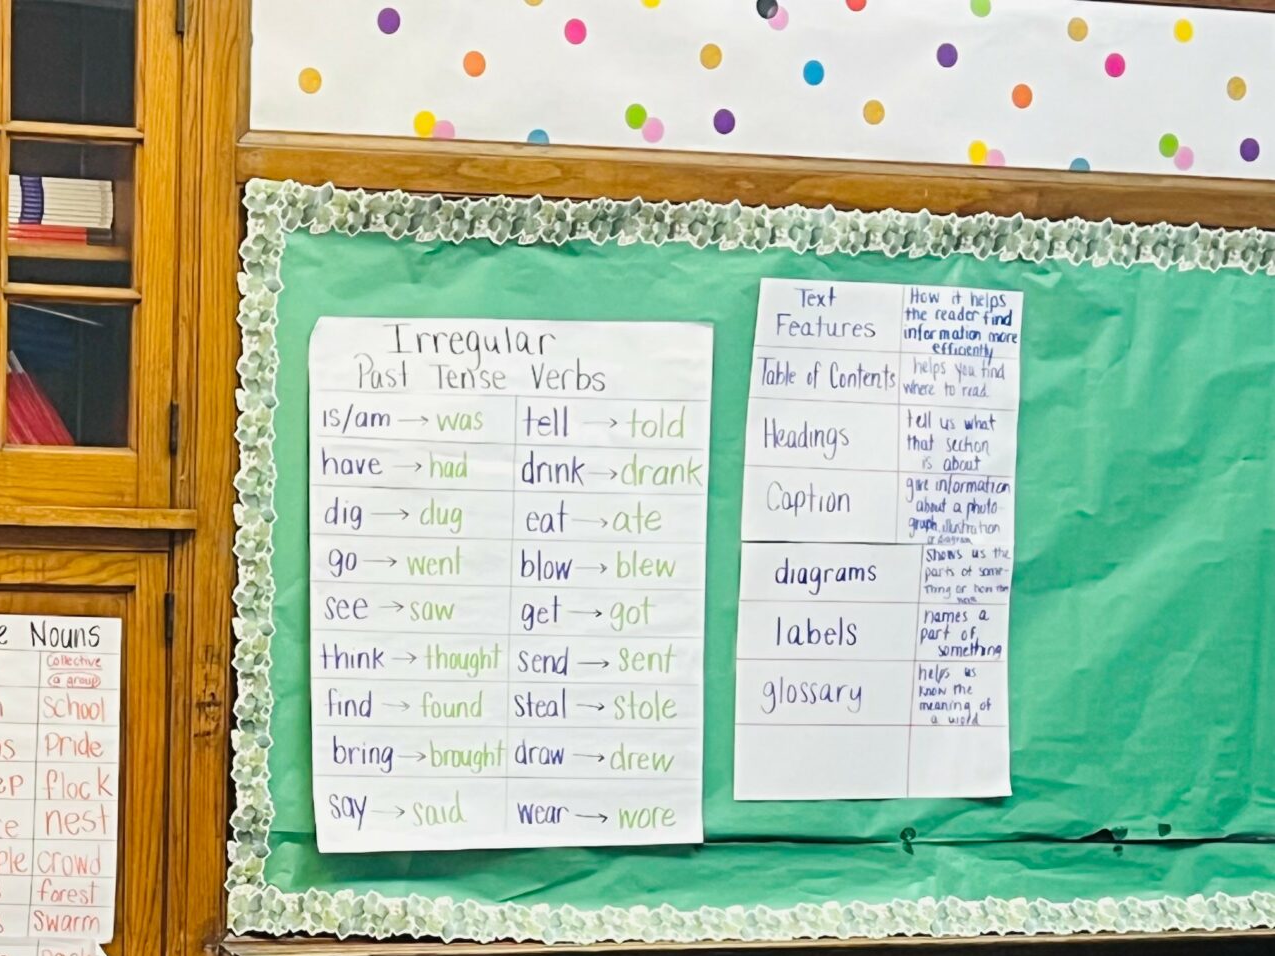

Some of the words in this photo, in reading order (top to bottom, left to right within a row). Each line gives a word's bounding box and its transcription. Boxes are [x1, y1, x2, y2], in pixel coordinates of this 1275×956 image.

[795, 286, 837, 307] Text
[910, 287, 940, 304] How
[971, 292, 1006, 313] helps
[776, 313, 876, 338] Features
[904, 307, 927, 320] the
[935, 306, 979, 321] reader
[983, 309, 1012, 326] find
[383, 322, 556, 367] Irregular
[904, 323, 981, 341] information
[989, 332, 1018, 343] more
[354, 353, 410, 391] Past
[430, 362, 507, 391] Tense
[530, 358, 606, 393] Verbs
[757, 356, 797, 386] Table
[807, 361, 822, 388] of
[830, 361, 896, 389] Contents
[913, 356, 946, 381] helps
[955, 362, 975, 383] you
[981, 361, 1005, 380] find
[903, 380, 934, 395] where
[945, 381, 956, 396] to
[322, 403, 391, 433] is/am
[436, 411, 484, 431] was
[523, 406, 569, 438] tell
[627, 406, 686, 439] told
[907, 409, 931, 428] tell
[940, 417, 956, 430] us
[965, 413, 996, 431] what
[764, 417, 850, 460] Headings
[907, 434, 933, 451] that
[946, 436, 990, 456] section
[321, 448, 383, 475] have
[429, 451, 468, 479] had
[521, 450, 586, 486] drink
[621, 450, 703, 487] drank
[922, 456, 932, 469] is
[943, 456, 981, 471] about
[936, 474, 1011, 494] information
[766, 481, 851, 517] Caption
[916, 497, 946, 513] about
[953, 502, 962, 513] a
[324, 497, 362, 531] dig
[420, 498, 463, 533] dug
[526, 500, 569, 533] eat
[612, 501, 662, 534] ate
[329, 548, 357, 577] go
[406, 546, 463, 576] went
[521, 549, 573, 581] blow
[617, 548, 676, 578] blew
[972, 549, 986, 558] us
[994, 547, 1011, 559] the
[775, 558, 877, 596] diagrams
[925, 567, 954, 583] parts
[924, 585, 951, 599] thing
[325, 596, 369, 622] see
[409, 601, 455, 622] saw
[521, 595, 562, 631] get
[610, 596, 657, 632] got
[924, 610, 968, 624] names
[979, 610, 989, 620] a
[30, 620, 101, 648] Nouns
[776, 616, 857, 646] labels
[920, 624, 950, 645] part
[961, 626, 976, 640] of
[46, 654, 101, 668] Collective
[321, 643, 385, 670] think
[425, 642, 503, 678] thought
[938, 637, 1002, 659] something
[919, 664, 950, 684] helps
[965, 667, 976, 677] us
[328, 688, 372, 718] find
[421, 690, 483, 719] found
[761, 676, 862, 714] glossary
[919, 686, 946, 697] know
[953, 684, 973, 695] the
[920, 701, 970, 716] meaning
[980, 698, 992, 711] of
[333, 736, 394, 774] bring
[430, 738, 506, 774] brought
[514, 739, 564, 767] draw
[610, 742, 675, 772] drew
[42, 767, 113, 800] flock
[45, 804, 110, 835] nest
[329, 793, 367, 831] say
[517, 800, 569, 825] wear
[618, 804, 677, 829] wore
[37, 878, 100, 904] forest
